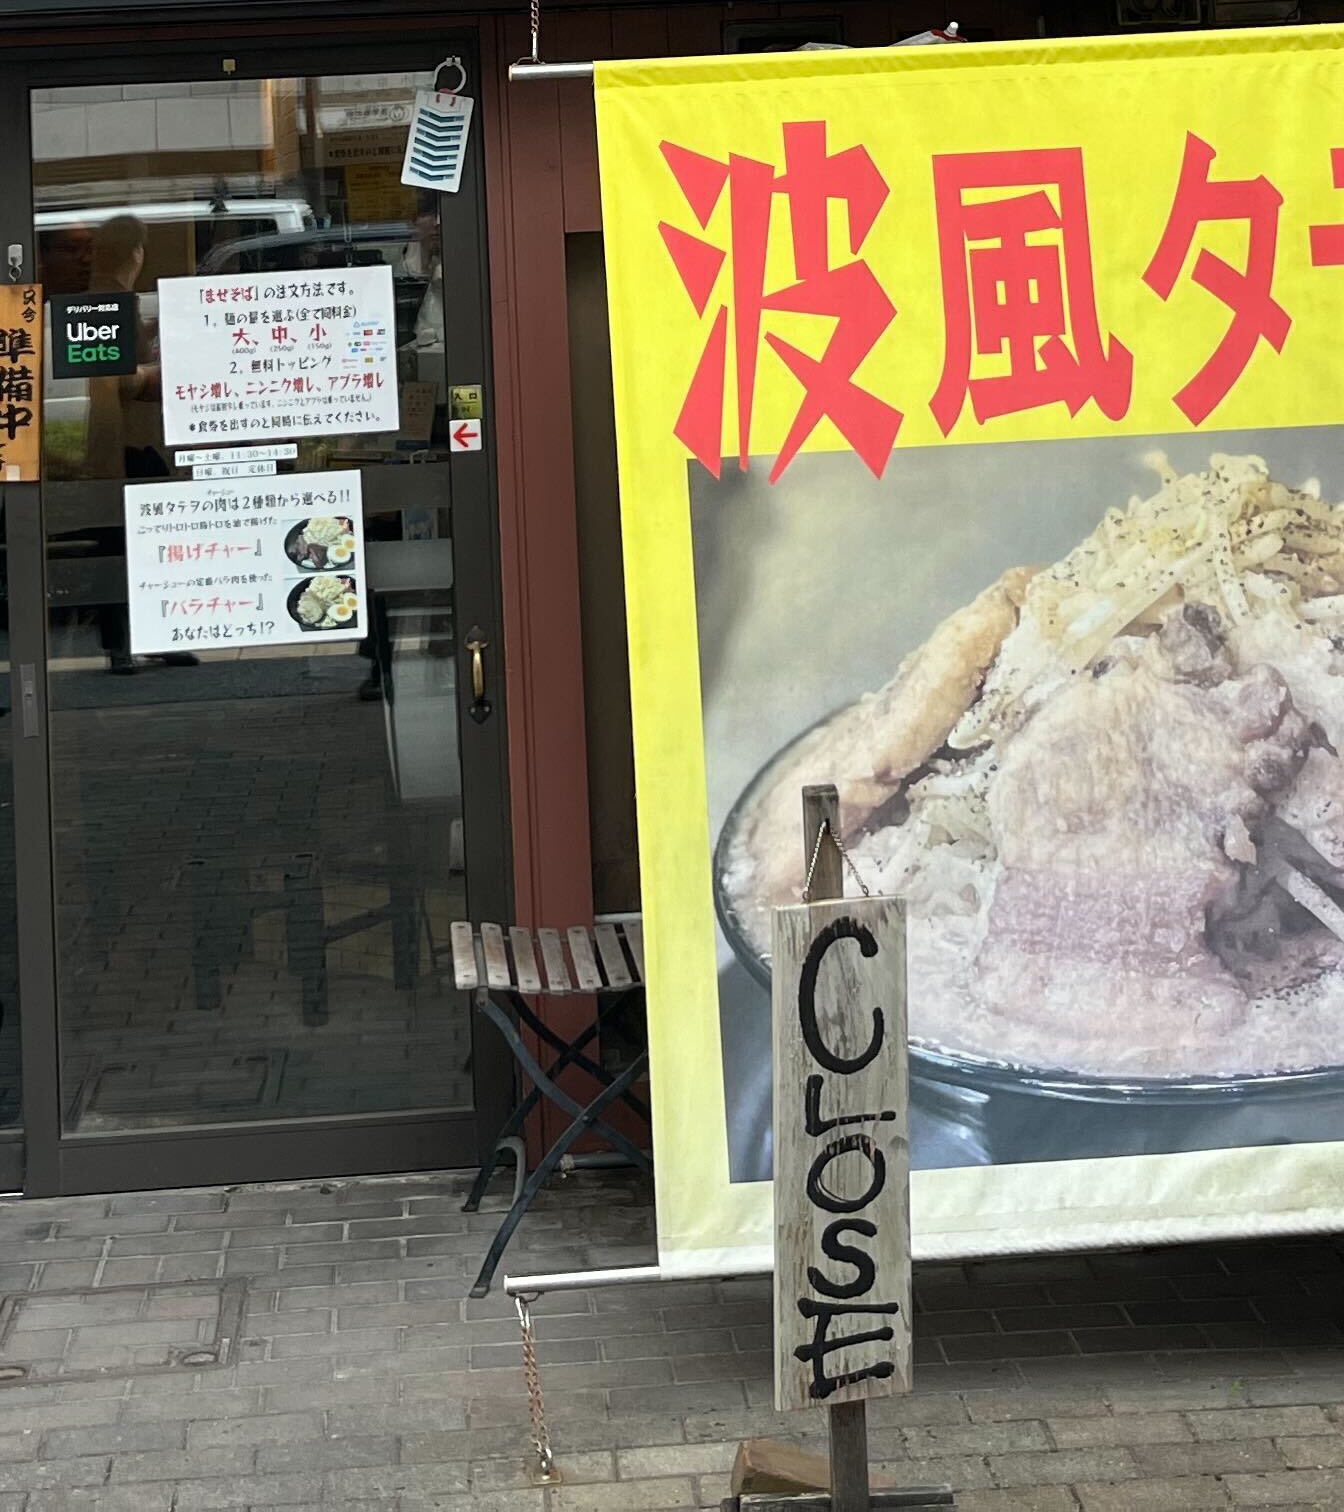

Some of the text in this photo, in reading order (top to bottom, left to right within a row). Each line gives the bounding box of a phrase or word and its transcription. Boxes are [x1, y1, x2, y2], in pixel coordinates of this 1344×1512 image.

[66, 322, 120, 342] Uber
[67, 344, 121, 364] Eats
[793, 915, 900, 1399] CLOSE
